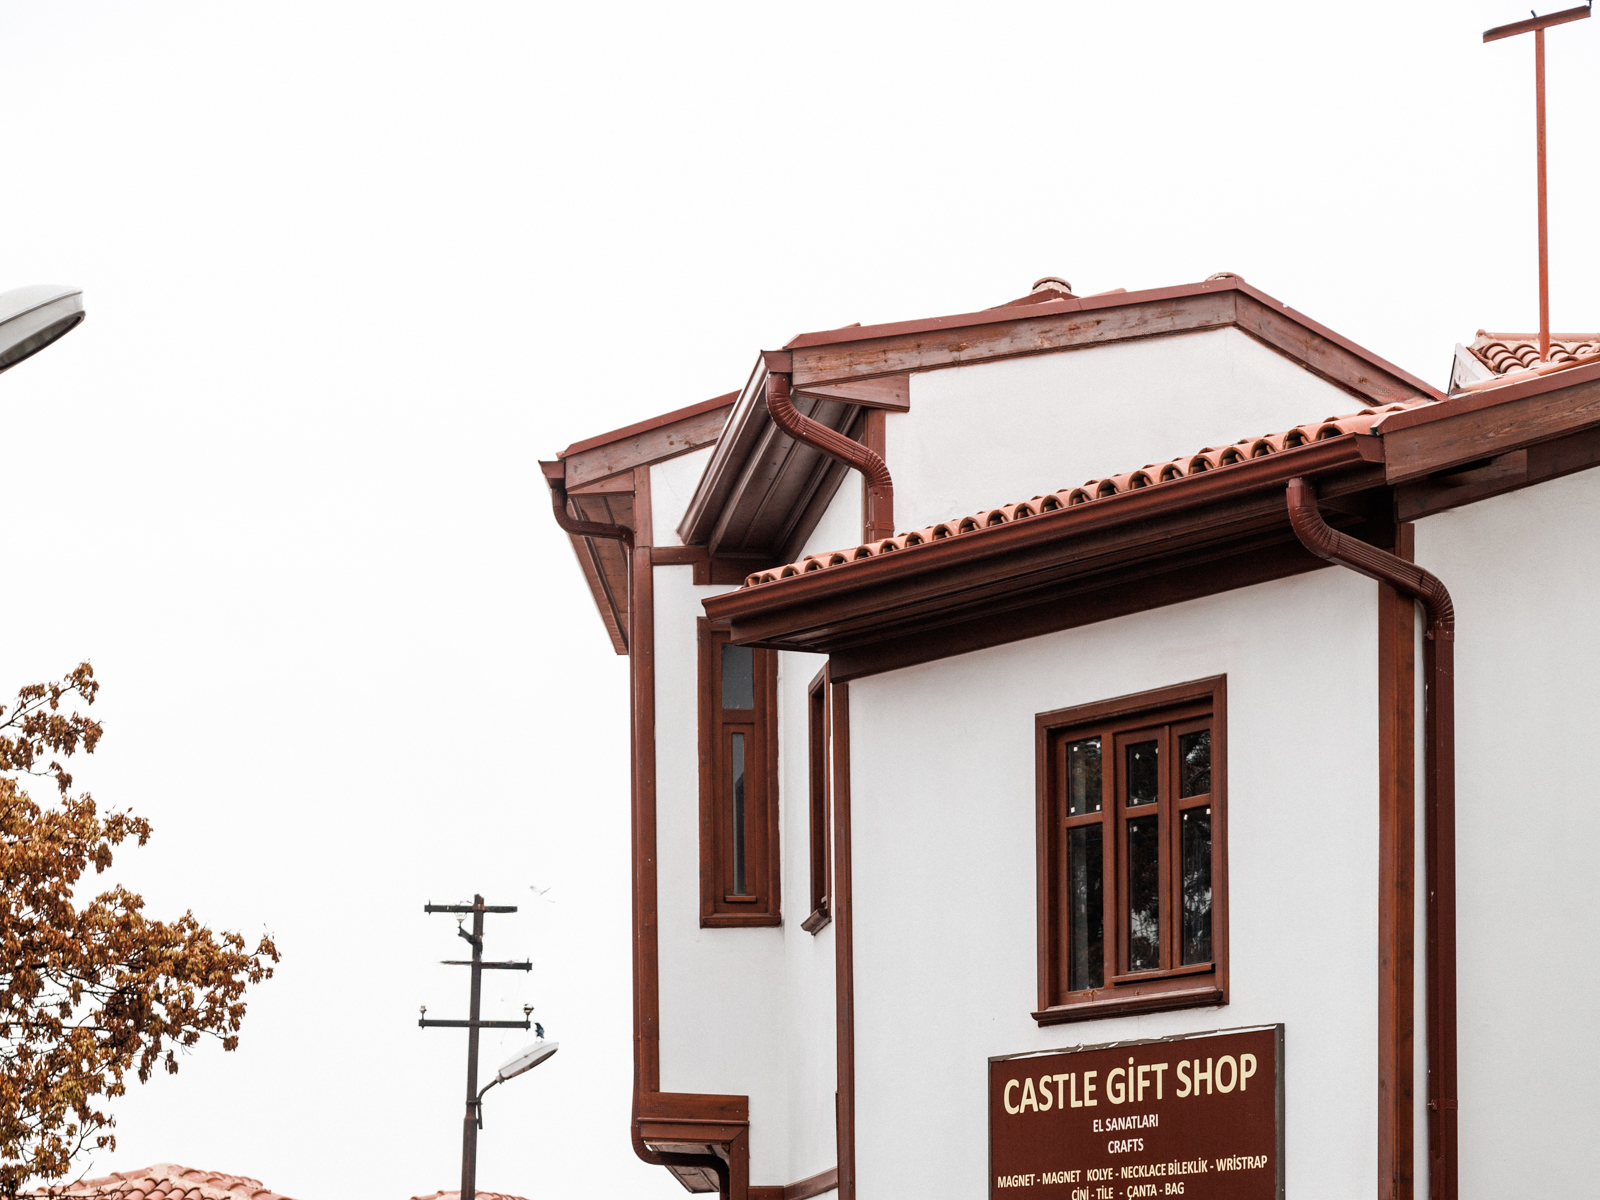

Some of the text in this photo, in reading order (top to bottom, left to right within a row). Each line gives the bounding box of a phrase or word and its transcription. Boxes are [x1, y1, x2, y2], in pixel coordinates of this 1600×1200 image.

[1003, 1053, 1258, 1115] CASTLE GİFT SHOP
[1093, 1113, 1159, 1133] EL SANATLARI
[1107, 1138, 1144, 1154] CRAFTS
[997, 1173, 1035, 1189] MAGNET
[1042, 1169, 1081, 1185] MAGNET
[1086, 1167, 1113, 1183] KOLYE
[1121, 1163, 1167, 1180] NECKLACE
[1168, 1157, 1208, 1176] BİLEKLİK
[1215, 1154, 1268, 1173] WRİSTRAP
[1096, 1184, 1114, 1200] TİLE
[1126, 1183, 1157, 1200] ÇANTA
[1165, 1181, 1185, 1196] BAG
